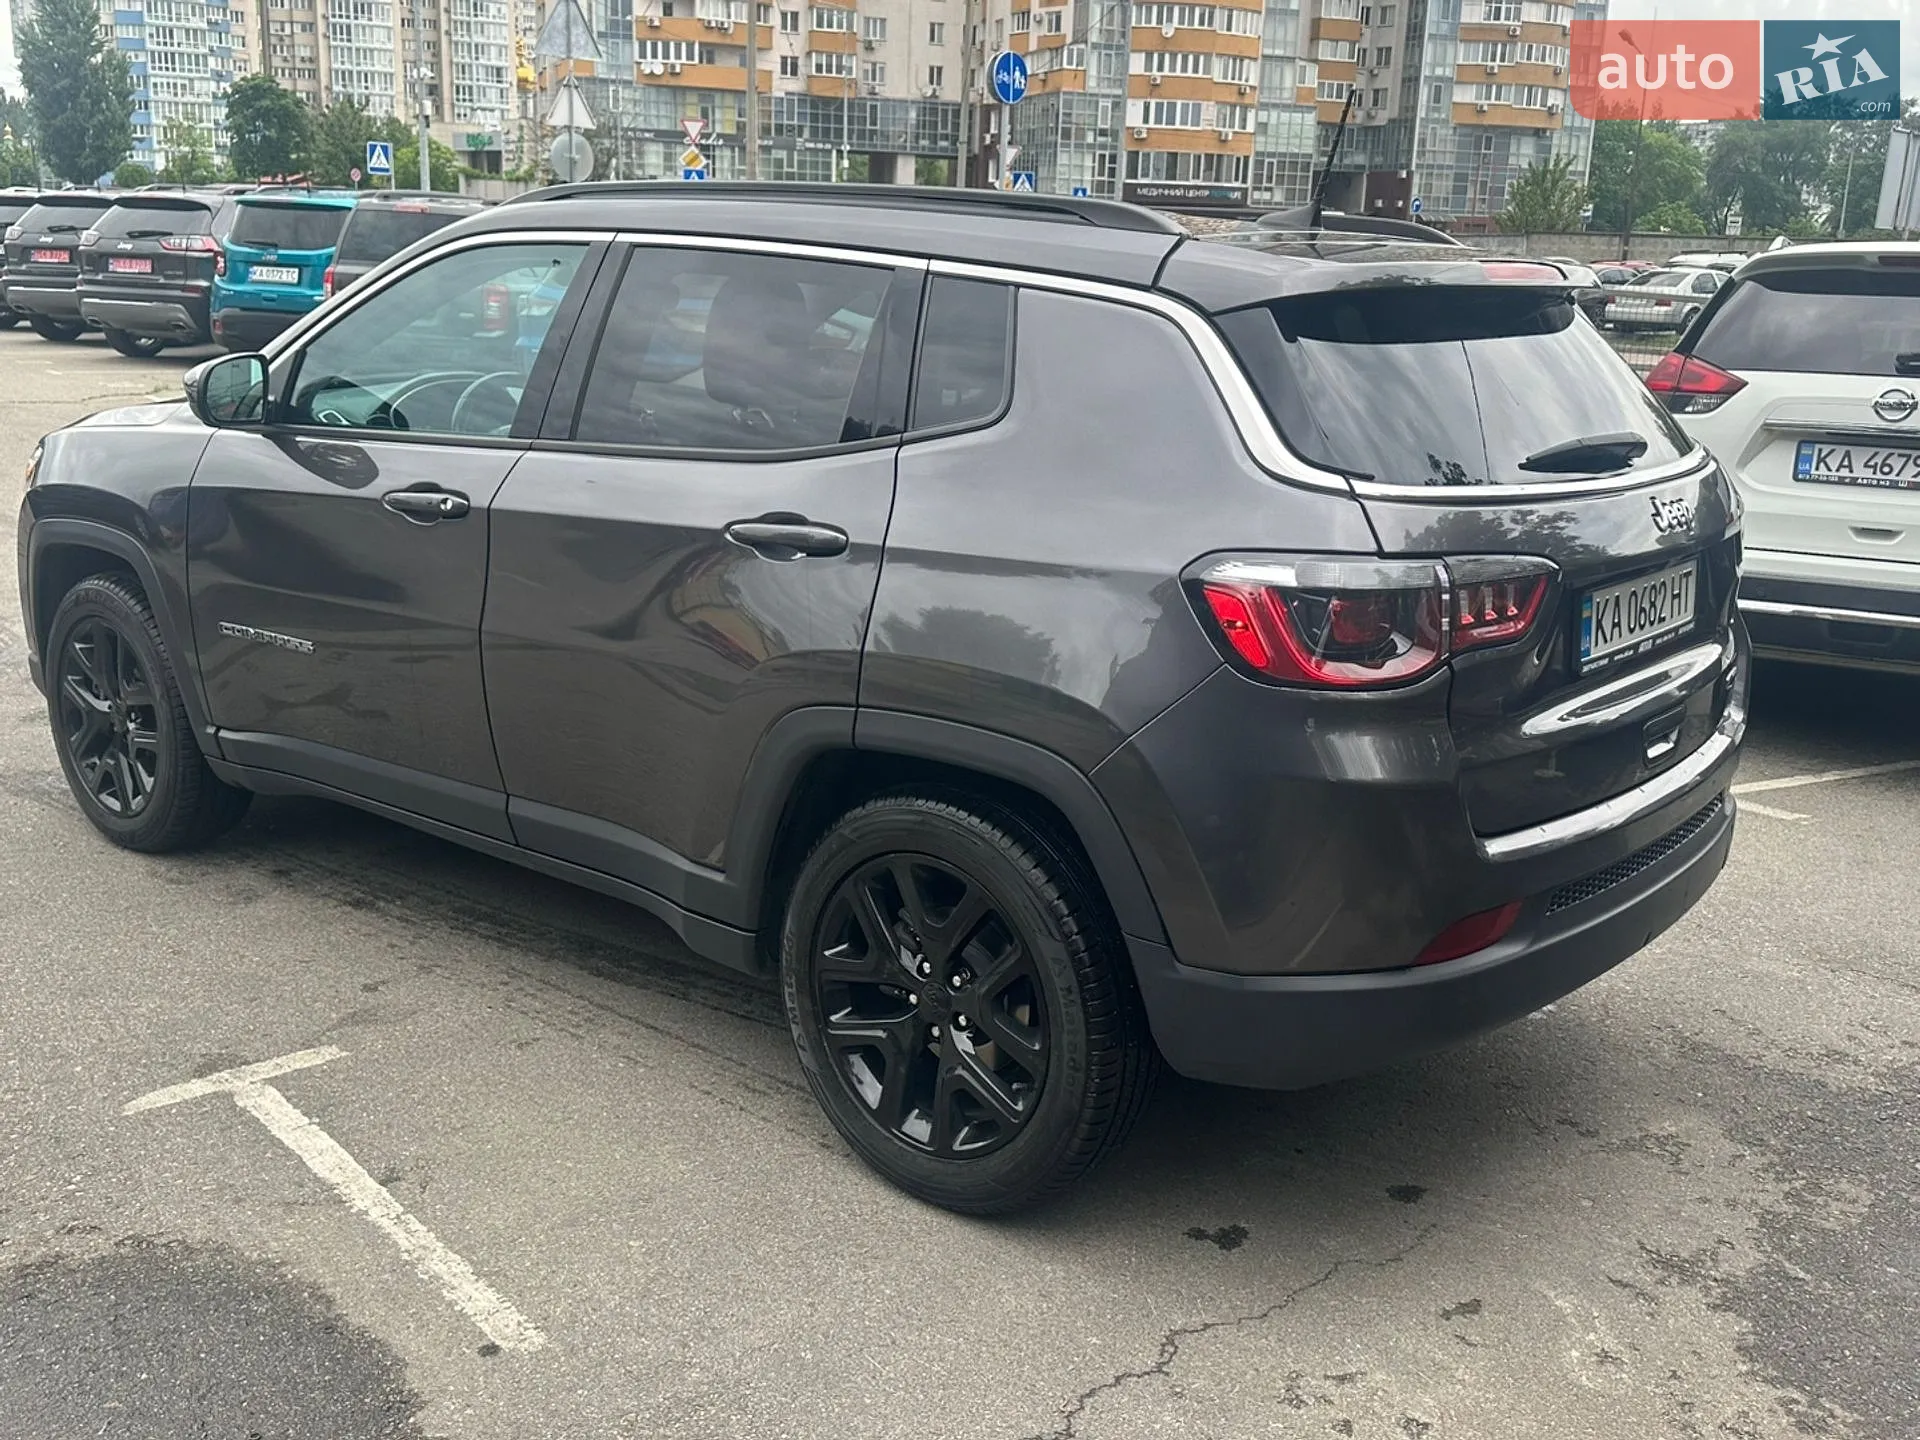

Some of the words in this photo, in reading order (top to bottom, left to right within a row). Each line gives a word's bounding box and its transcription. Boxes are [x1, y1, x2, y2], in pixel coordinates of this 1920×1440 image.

[1815, 447, 1854, 474] KA
[1649, 496, 1694, 534] Jeep
[1594, 594, 1623, 648] KA
[1627, 580, 1667, 634] 0682
[1670, 567, 1694, 619] HT
